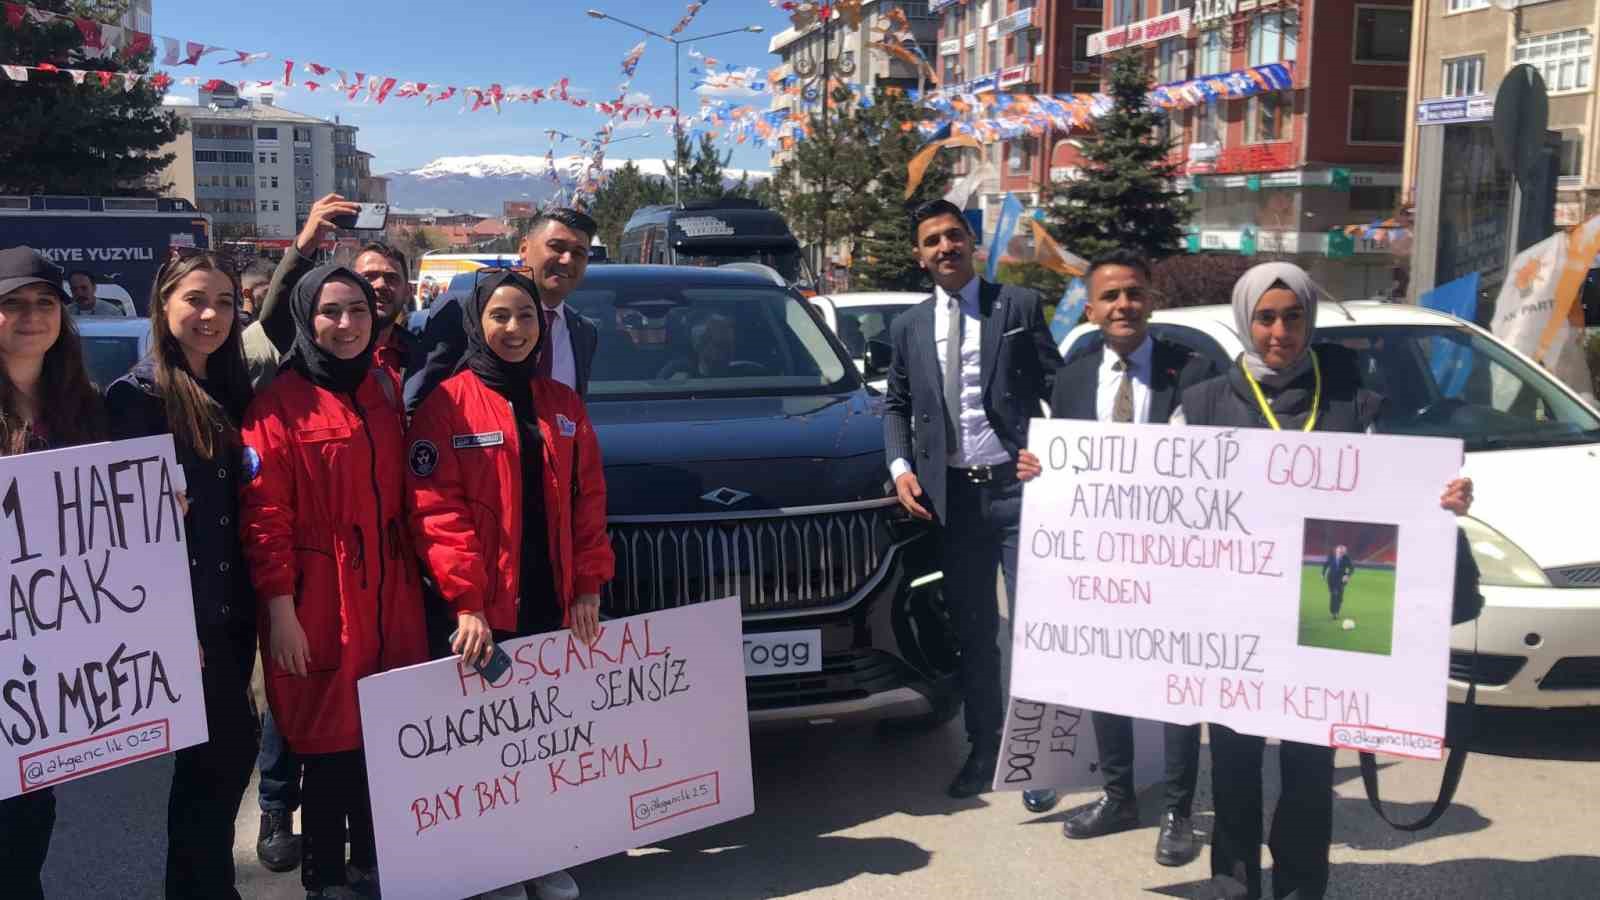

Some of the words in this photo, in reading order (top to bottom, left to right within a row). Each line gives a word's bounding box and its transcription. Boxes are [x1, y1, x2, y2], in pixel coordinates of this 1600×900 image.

[54, 456, 181, 557] HAFTA
[1067, 575, 1152, 605] YERDEN
[58, 642, 182, 734] MEFTA
[398, 685, 572, 758] OLACAKLAR
[591, 653, 690, 711] SENSİZ
[1167, 673, 1206, 708] BAY
[1219, 677, 1264, 711] BAY
[1283, 684, 1388, 729] KEMAL
[411, 785, 464, 835] BAY
[473, 771, 521, 816] BAY
[548, 738, 663, 795] KEMAL
[501, 720, 596, 768] OLSUN
